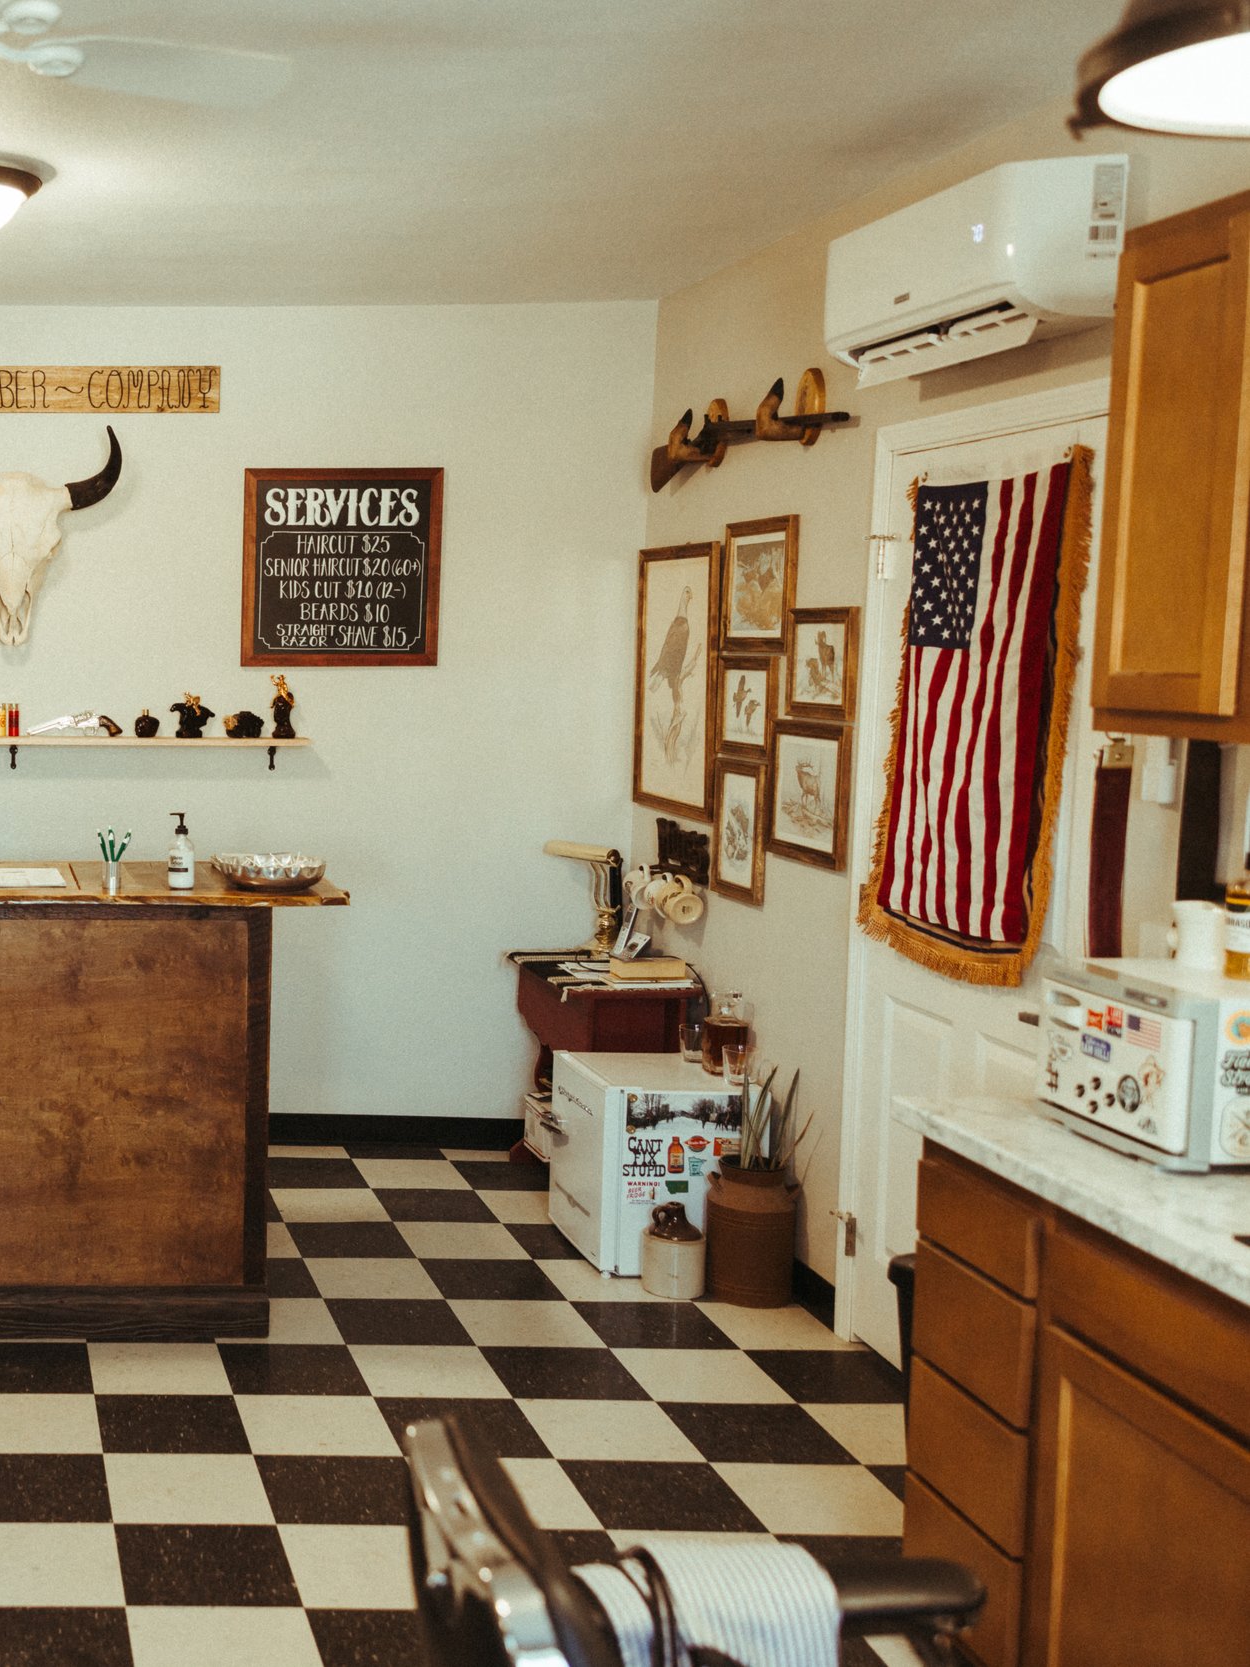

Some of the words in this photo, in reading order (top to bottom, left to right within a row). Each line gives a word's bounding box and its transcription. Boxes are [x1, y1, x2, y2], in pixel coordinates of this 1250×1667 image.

[87, 368, 218, 409] COMPANY
[264, 487, 420, 527] SERVICES
[296, 534, 358, 555] HAIRCUT
[361, 534, 391, 555] $25
[264, 557, 310, 577] SENIOR
[312, 557, 362, 577] HAIRCUT
[362, 557, 391, 577] $20
[279, 580, 310, 599] KIDS
[314, 580, 342, 599] CUT
[344, 580, 374, 600] $20
[299, 602, 359, 621] BEARDS
[363, 603, 390, 624] $10
[276, 624, 336, 636] STRAIGHT
[335, 625, 379, 647] SHAVE
[382, 625, 407, 647] $15
[281, 635, 329, 647] RAZOR
[633, 1151, 657, 1166] FIX
[622, 1164, 666, 1177] STUPID
